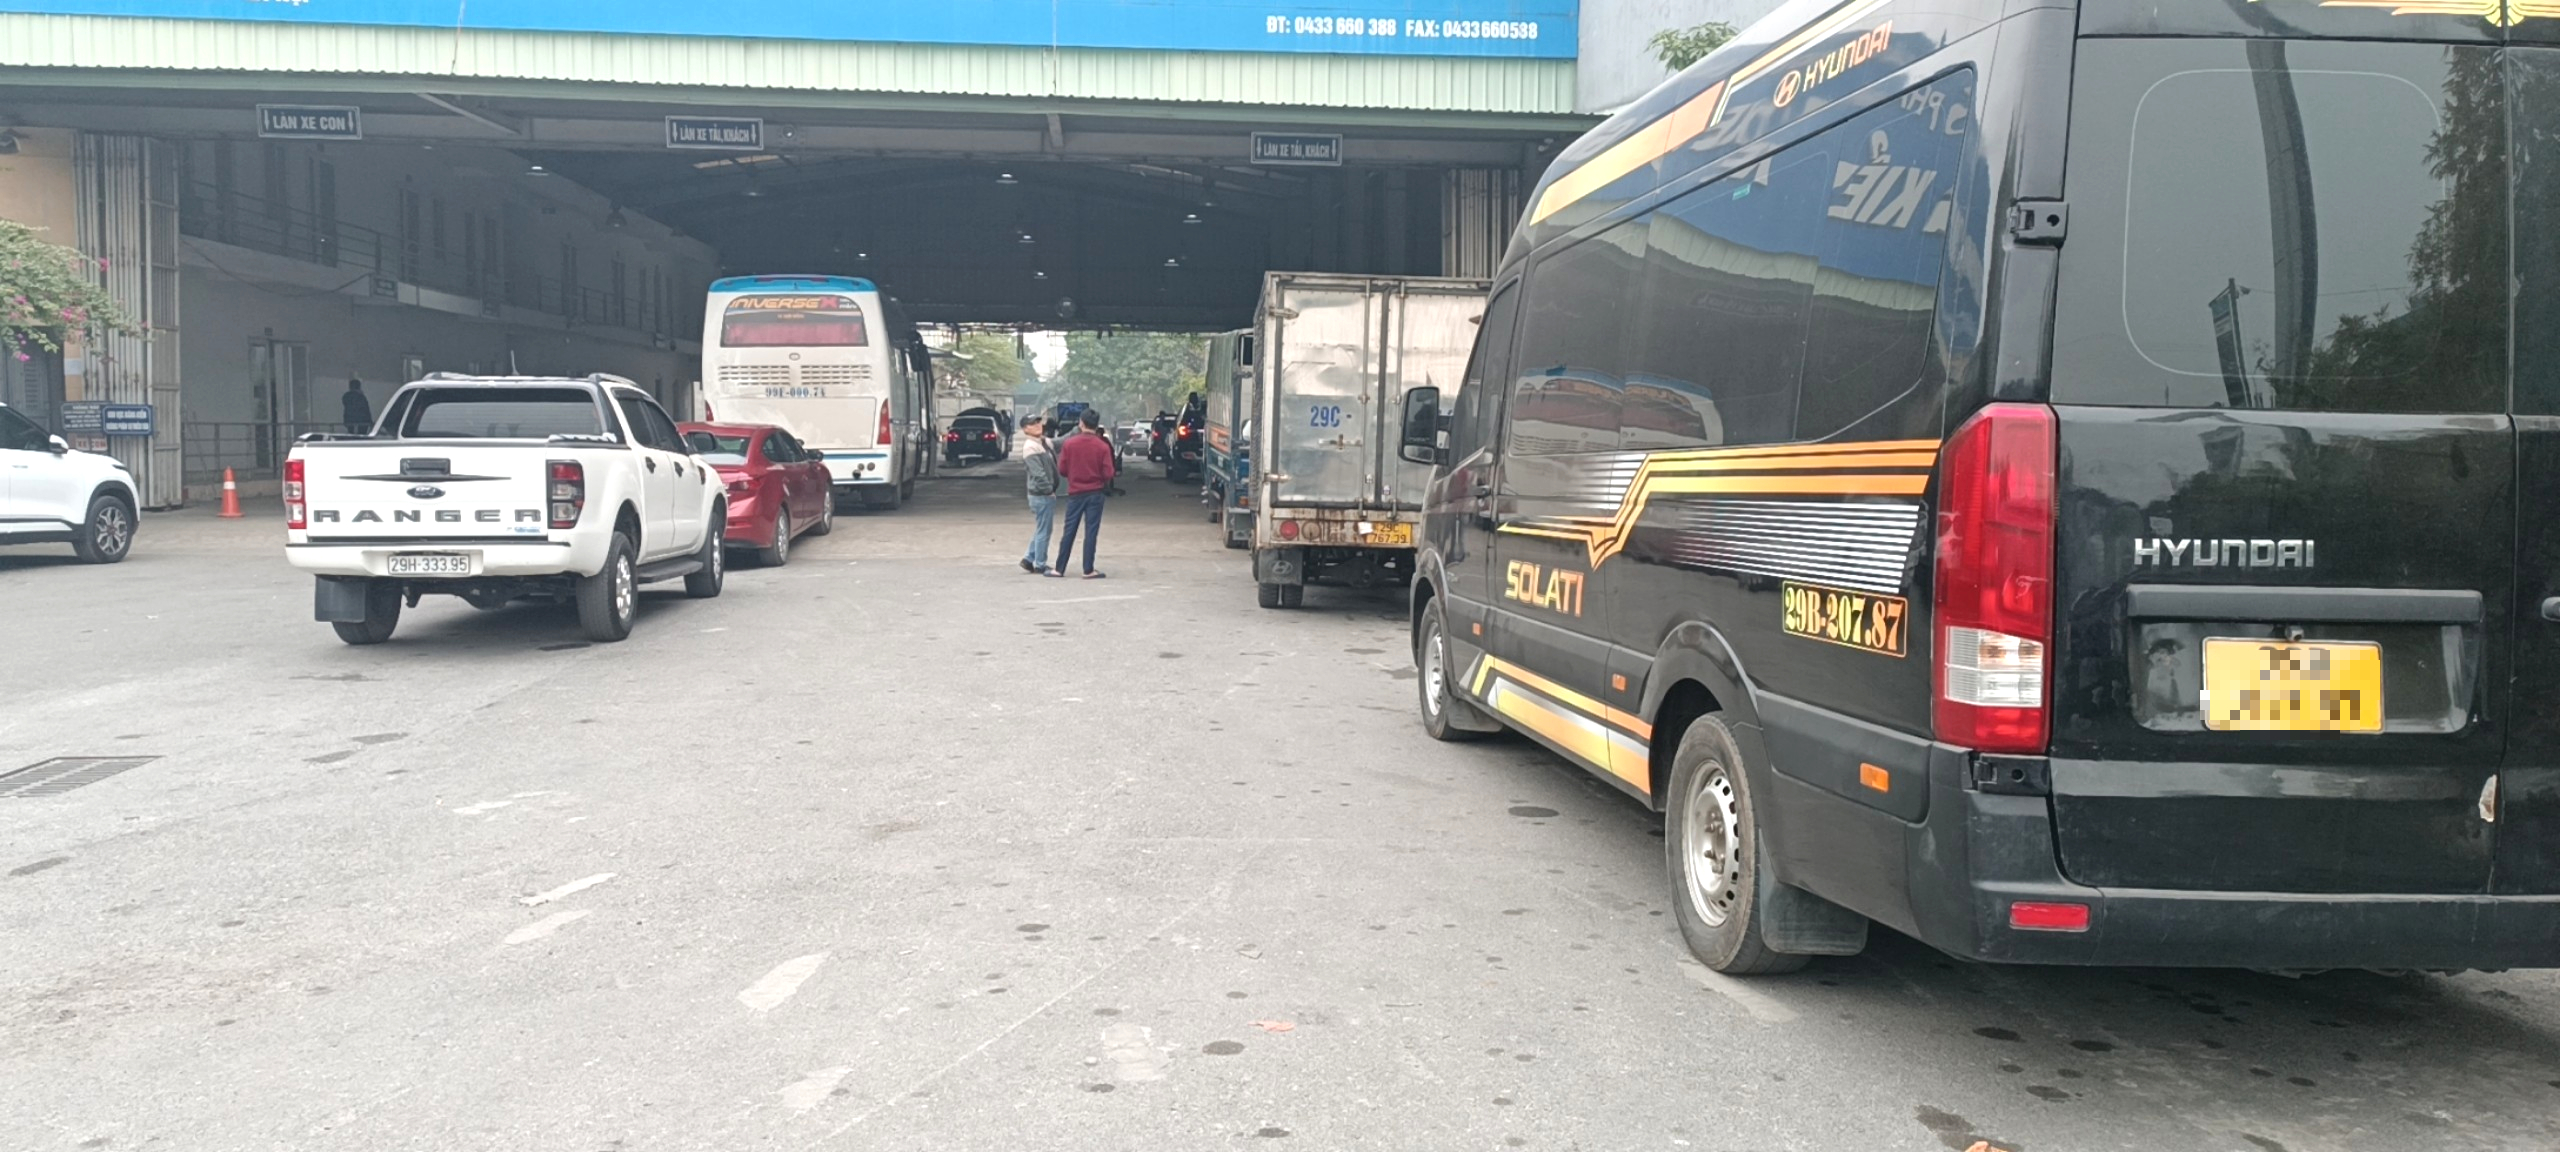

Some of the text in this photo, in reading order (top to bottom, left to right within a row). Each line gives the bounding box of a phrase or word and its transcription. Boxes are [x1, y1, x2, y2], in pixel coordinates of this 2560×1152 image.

[1266, 15, 1291, 34] ĐT:
[1294, 16, 1333, 34] 0433
[1336, 17, 1364, 35] 660
[1368, 18, 1397, 36] 388
[1405, 19, 1440, 37] FAX:
[1802, 19, 1893, 92] HYUNDAI
[272, 111, 346, 131] LÀN XE CON
[696, 127, 707, 141] XE
[1279, 143, 1290, 157] XE
[313, 509, 542, 523] RANGER
[2133, 538, 2315, 568] HYUNDAI
[391, 557, 468, 573] 29H-333.95
[1504, 560, 1585, 618] SOLATI
[1785, 586, 1903, 651] 29B-207.87
